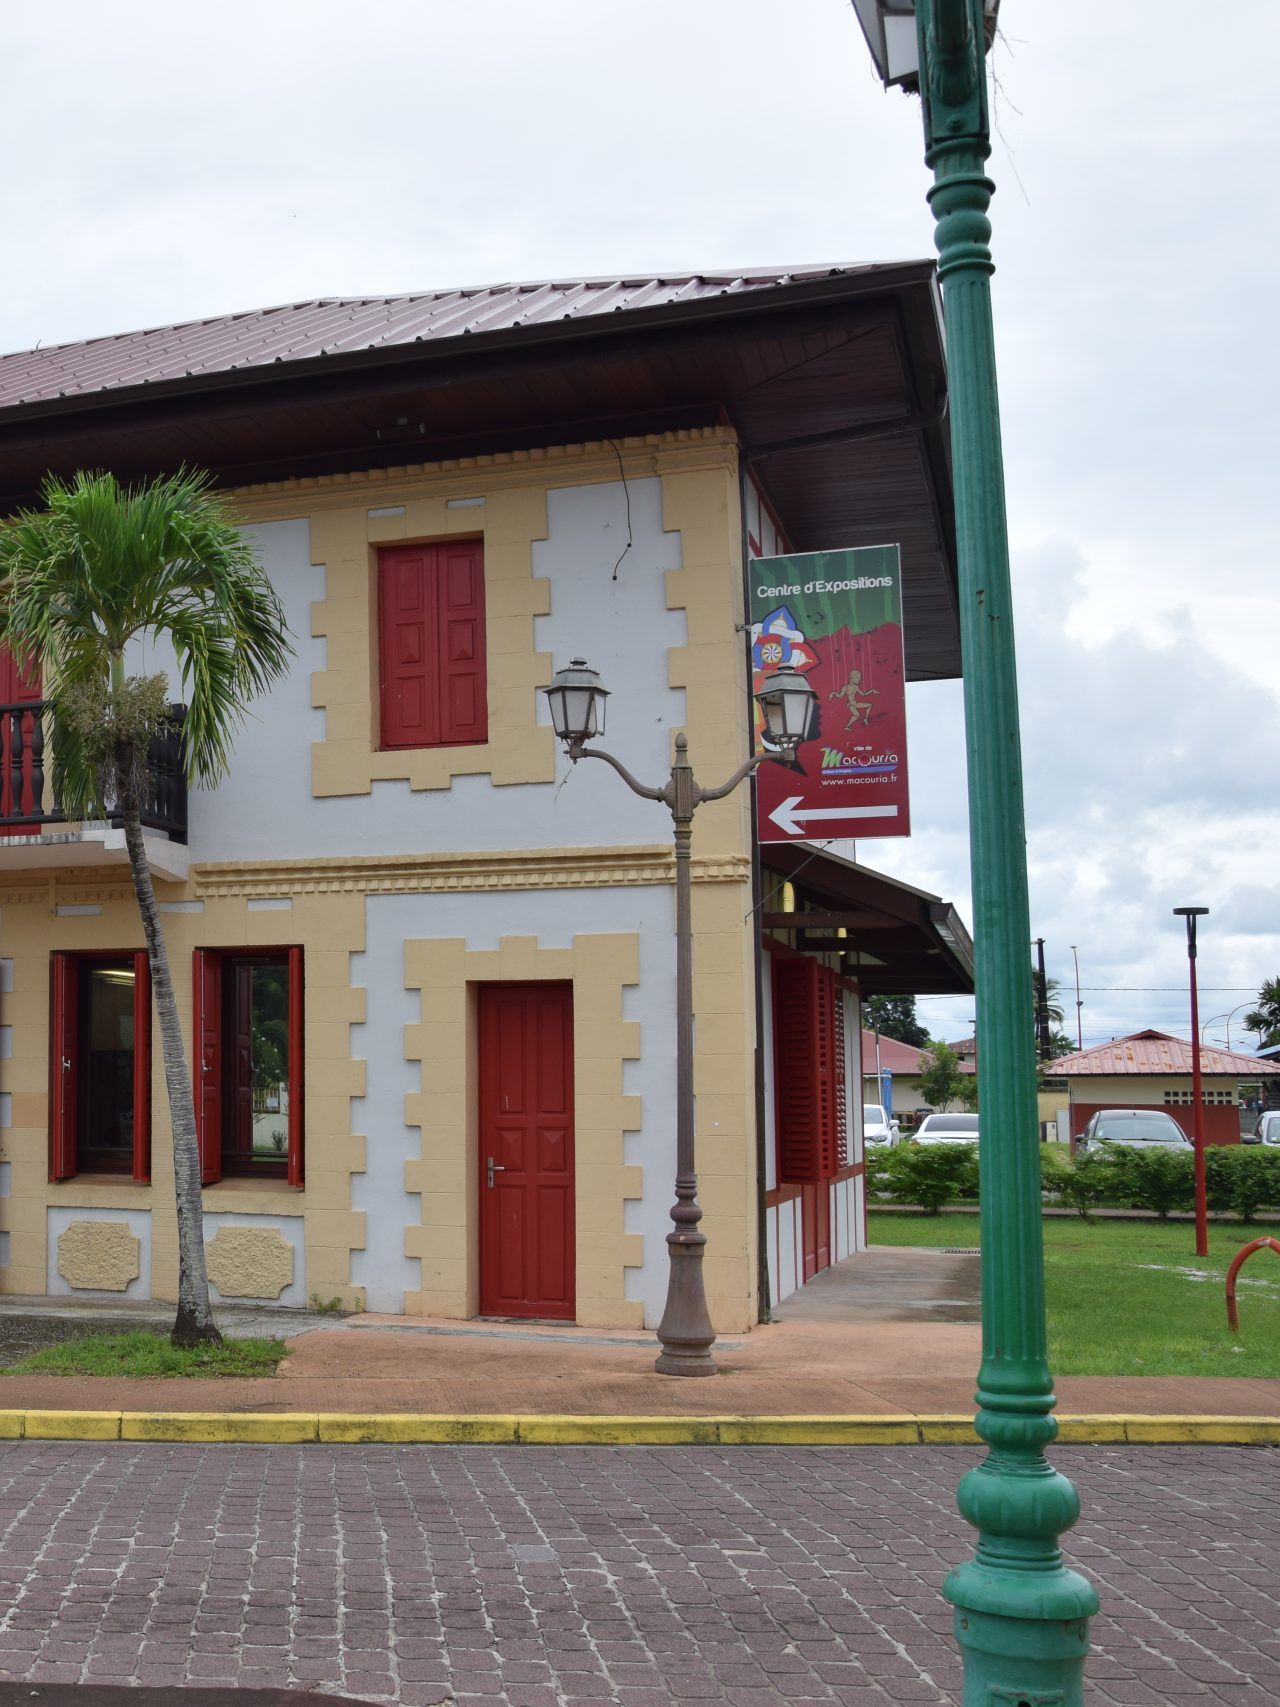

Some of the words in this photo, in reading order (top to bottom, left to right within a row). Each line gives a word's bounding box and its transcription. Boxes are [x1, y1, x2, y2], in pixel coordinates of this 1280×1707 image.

[757, 584, 801, 598] Centre
[804, 576, 893, 594] d'Expositions
[821, 773, 897, 785] www.macouria.fr
